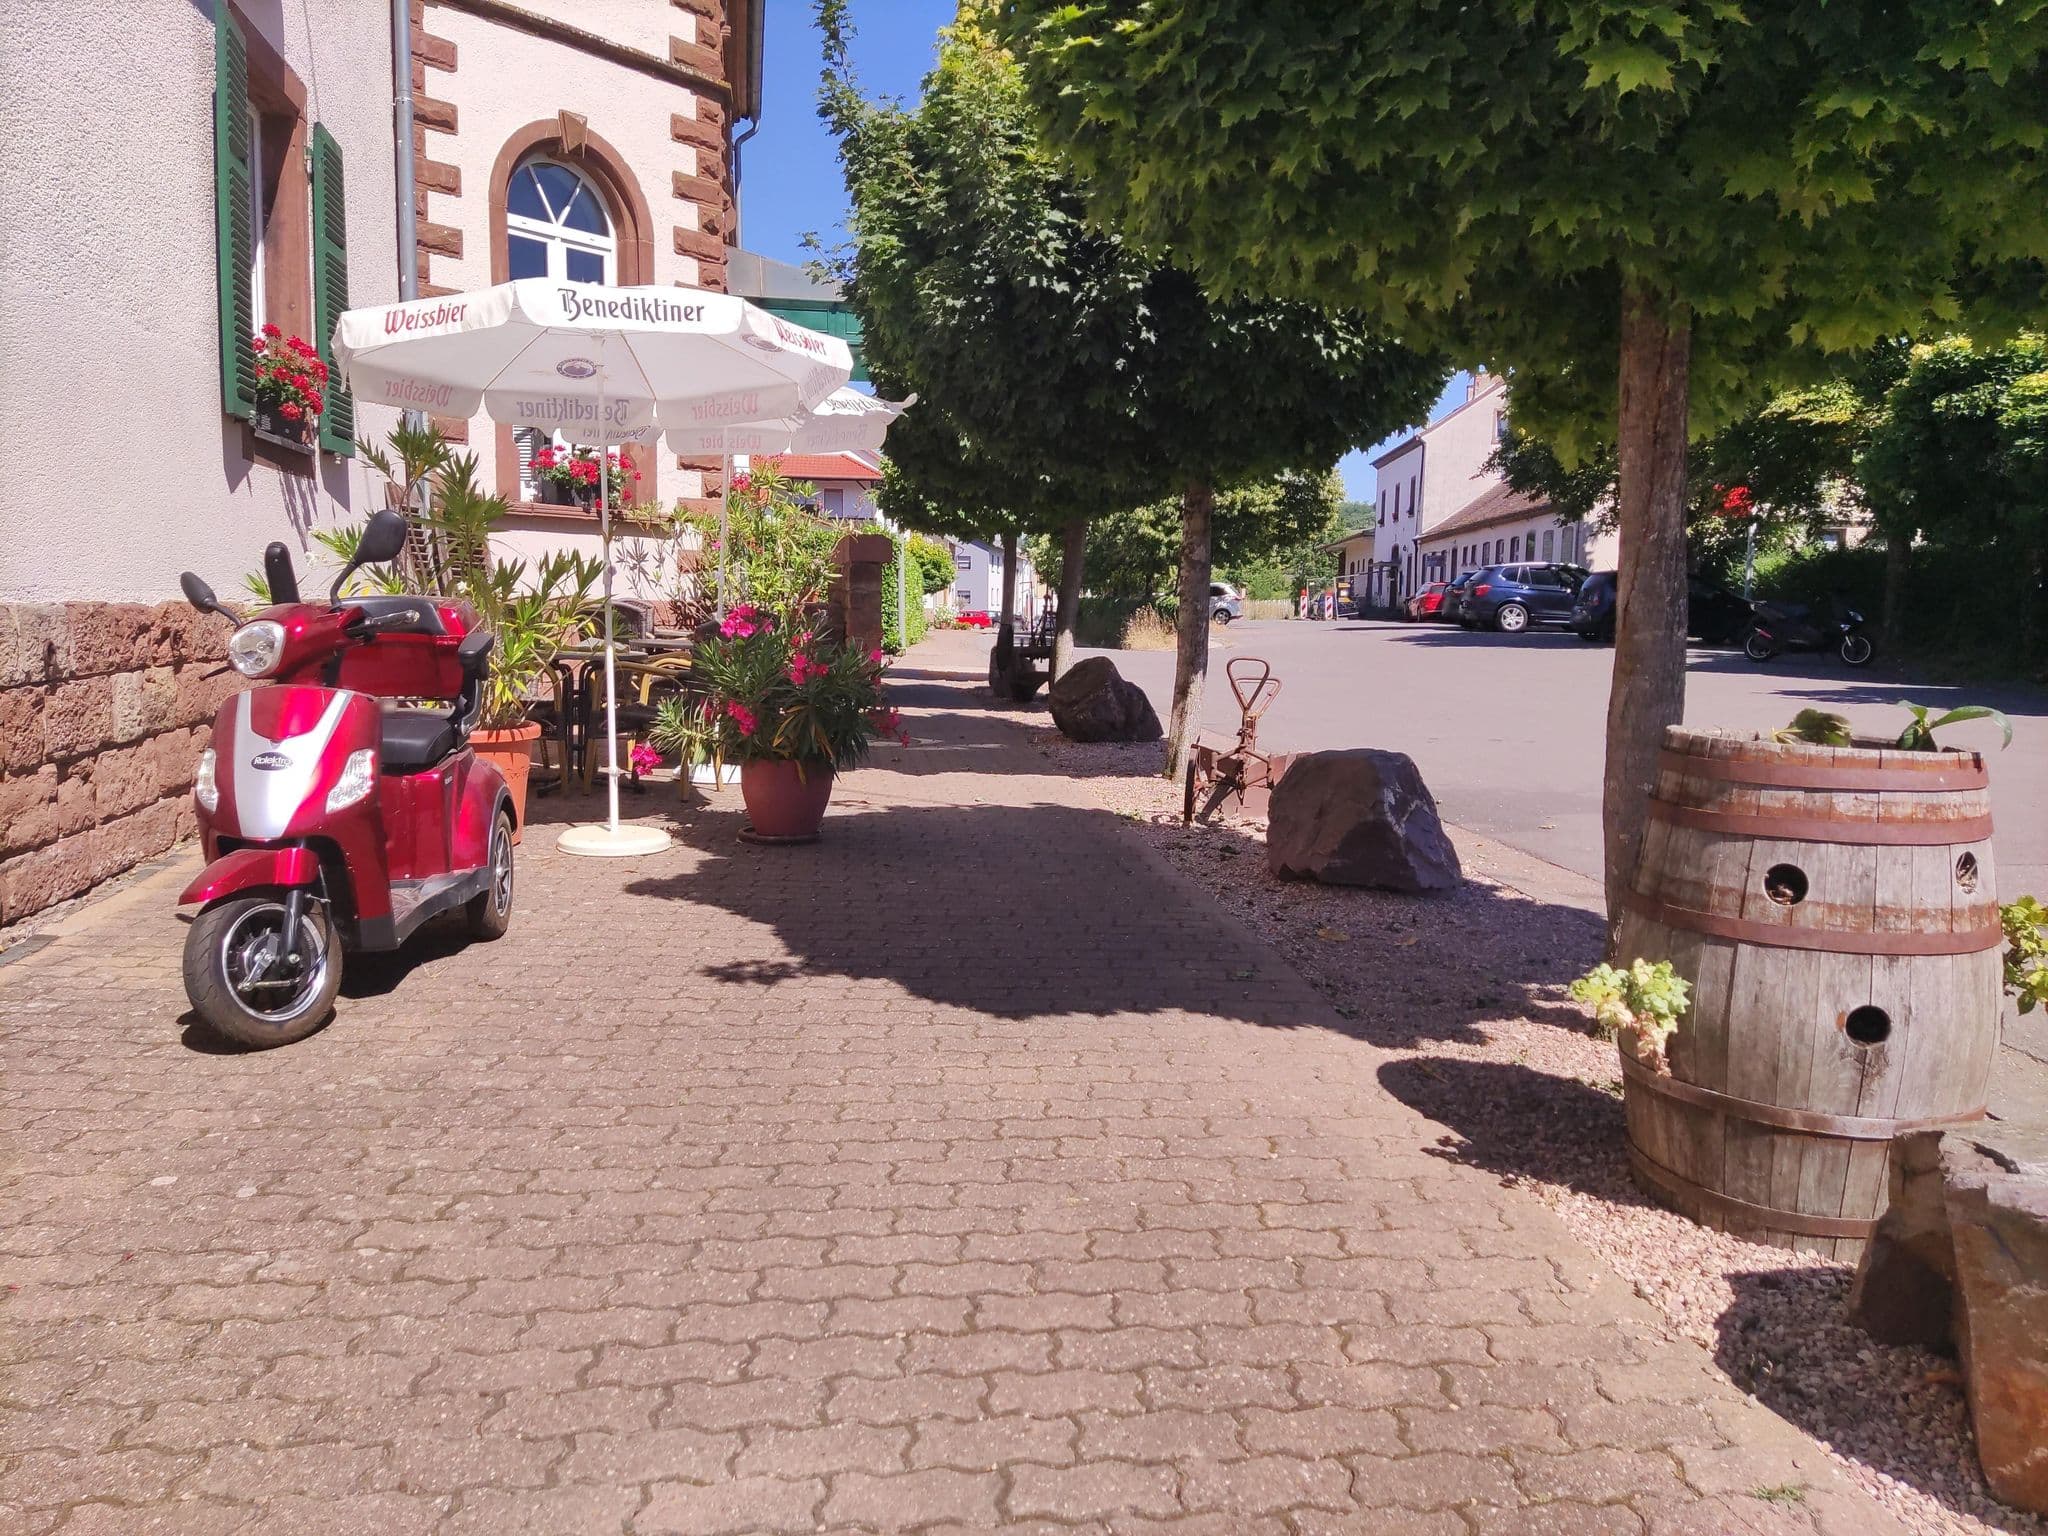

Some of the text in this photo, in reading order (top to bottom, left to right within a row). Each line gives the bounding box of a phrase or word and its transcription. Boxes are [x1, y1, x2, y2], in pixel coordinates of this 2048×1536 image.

[384, 301, 468, 335] Weissbier
[557, 288, 705, 322] Benediktiner
[253, 755, 291, 767] Rolektro
